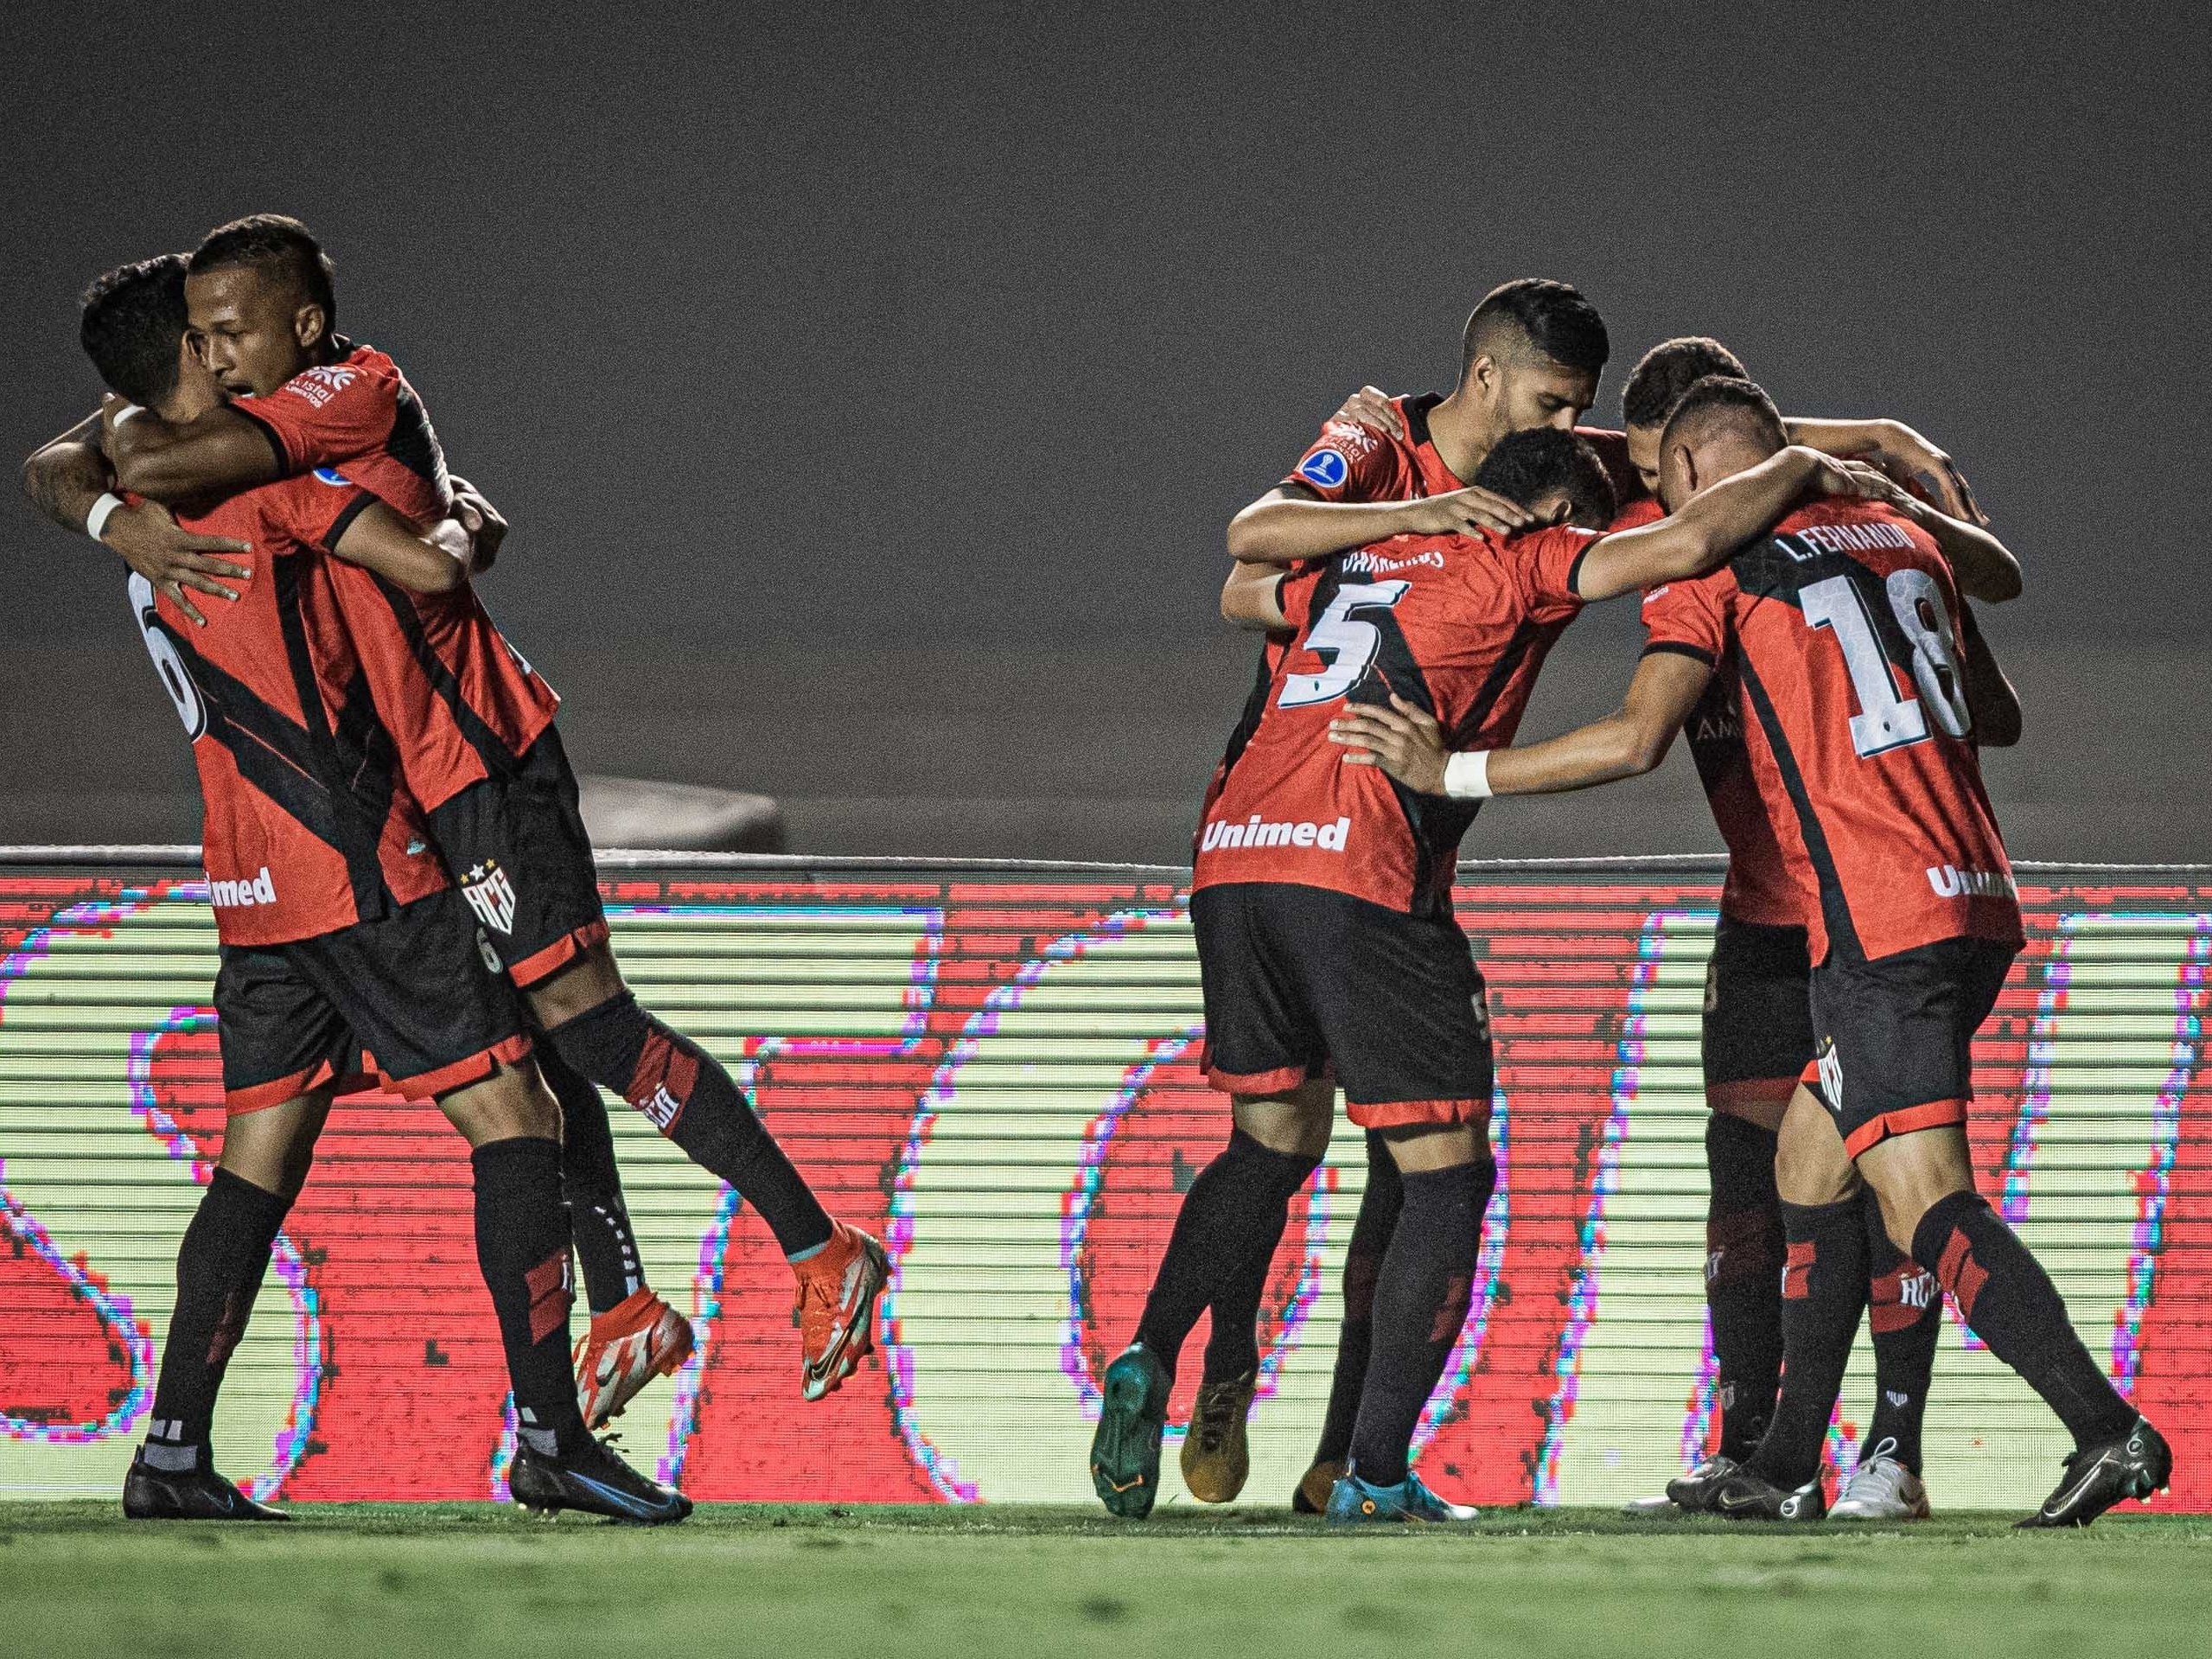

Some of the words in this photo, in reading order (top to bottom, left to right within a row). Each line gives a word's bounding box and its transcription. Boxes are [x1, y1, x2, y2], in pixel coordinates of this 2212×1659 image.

[1276, 579, 1412, 709] 5
[1798, 568, 1973, 761] 18
[1202, 814, 1351, 852] Unimed
